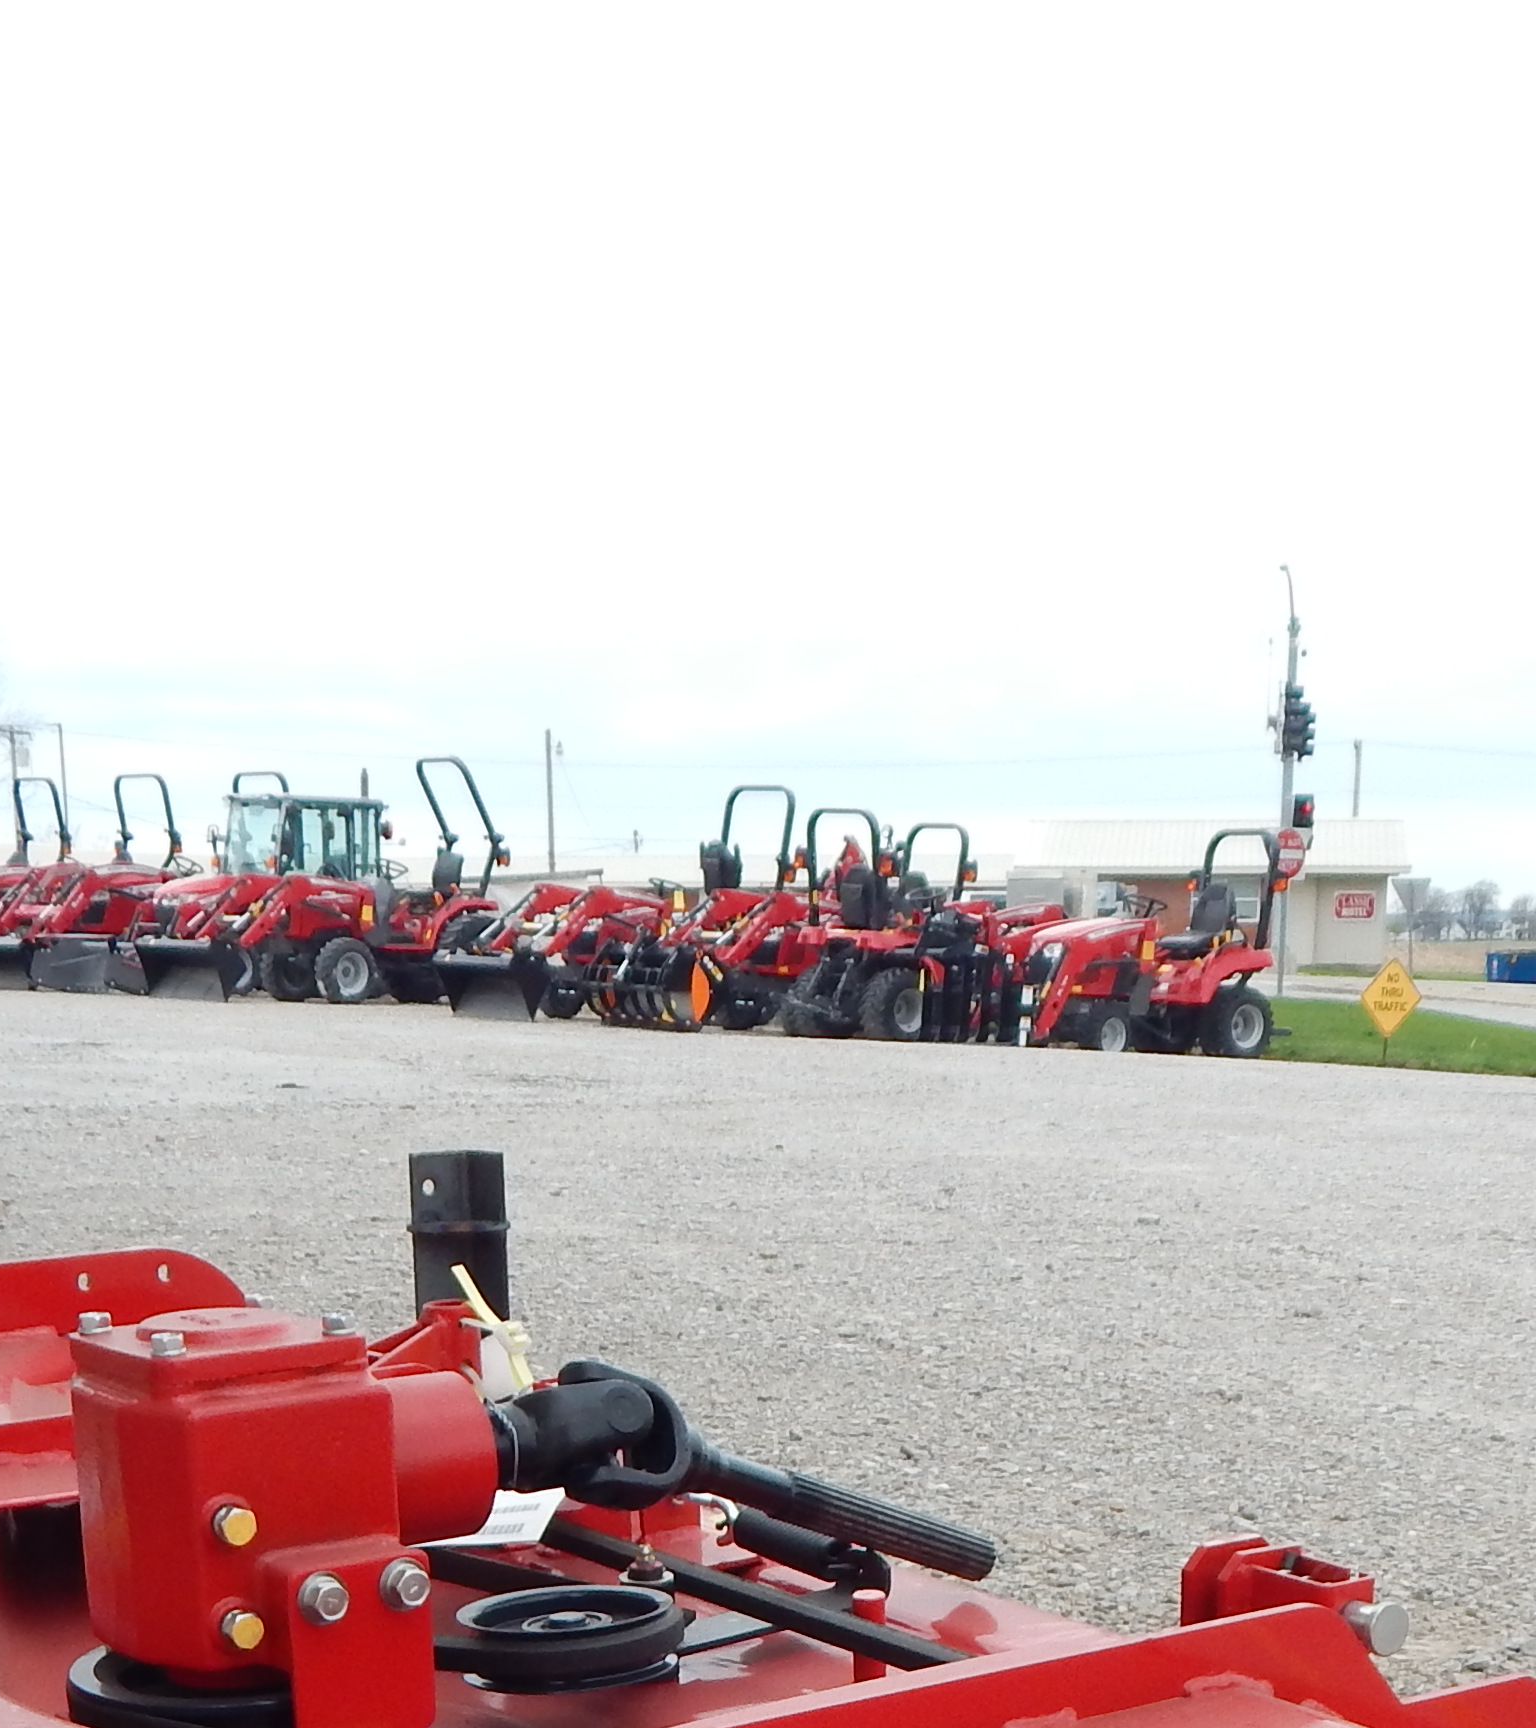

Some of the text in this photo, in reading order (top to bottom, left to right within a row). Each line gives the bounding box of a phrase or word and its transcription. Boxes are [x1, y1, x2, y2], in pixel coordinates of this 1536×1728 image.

[1386, 972, 1400, 983] NO
[1381, 986, 1404, 997] THRU
[1373, 1000, 1409, 1012] TRAFFIC
